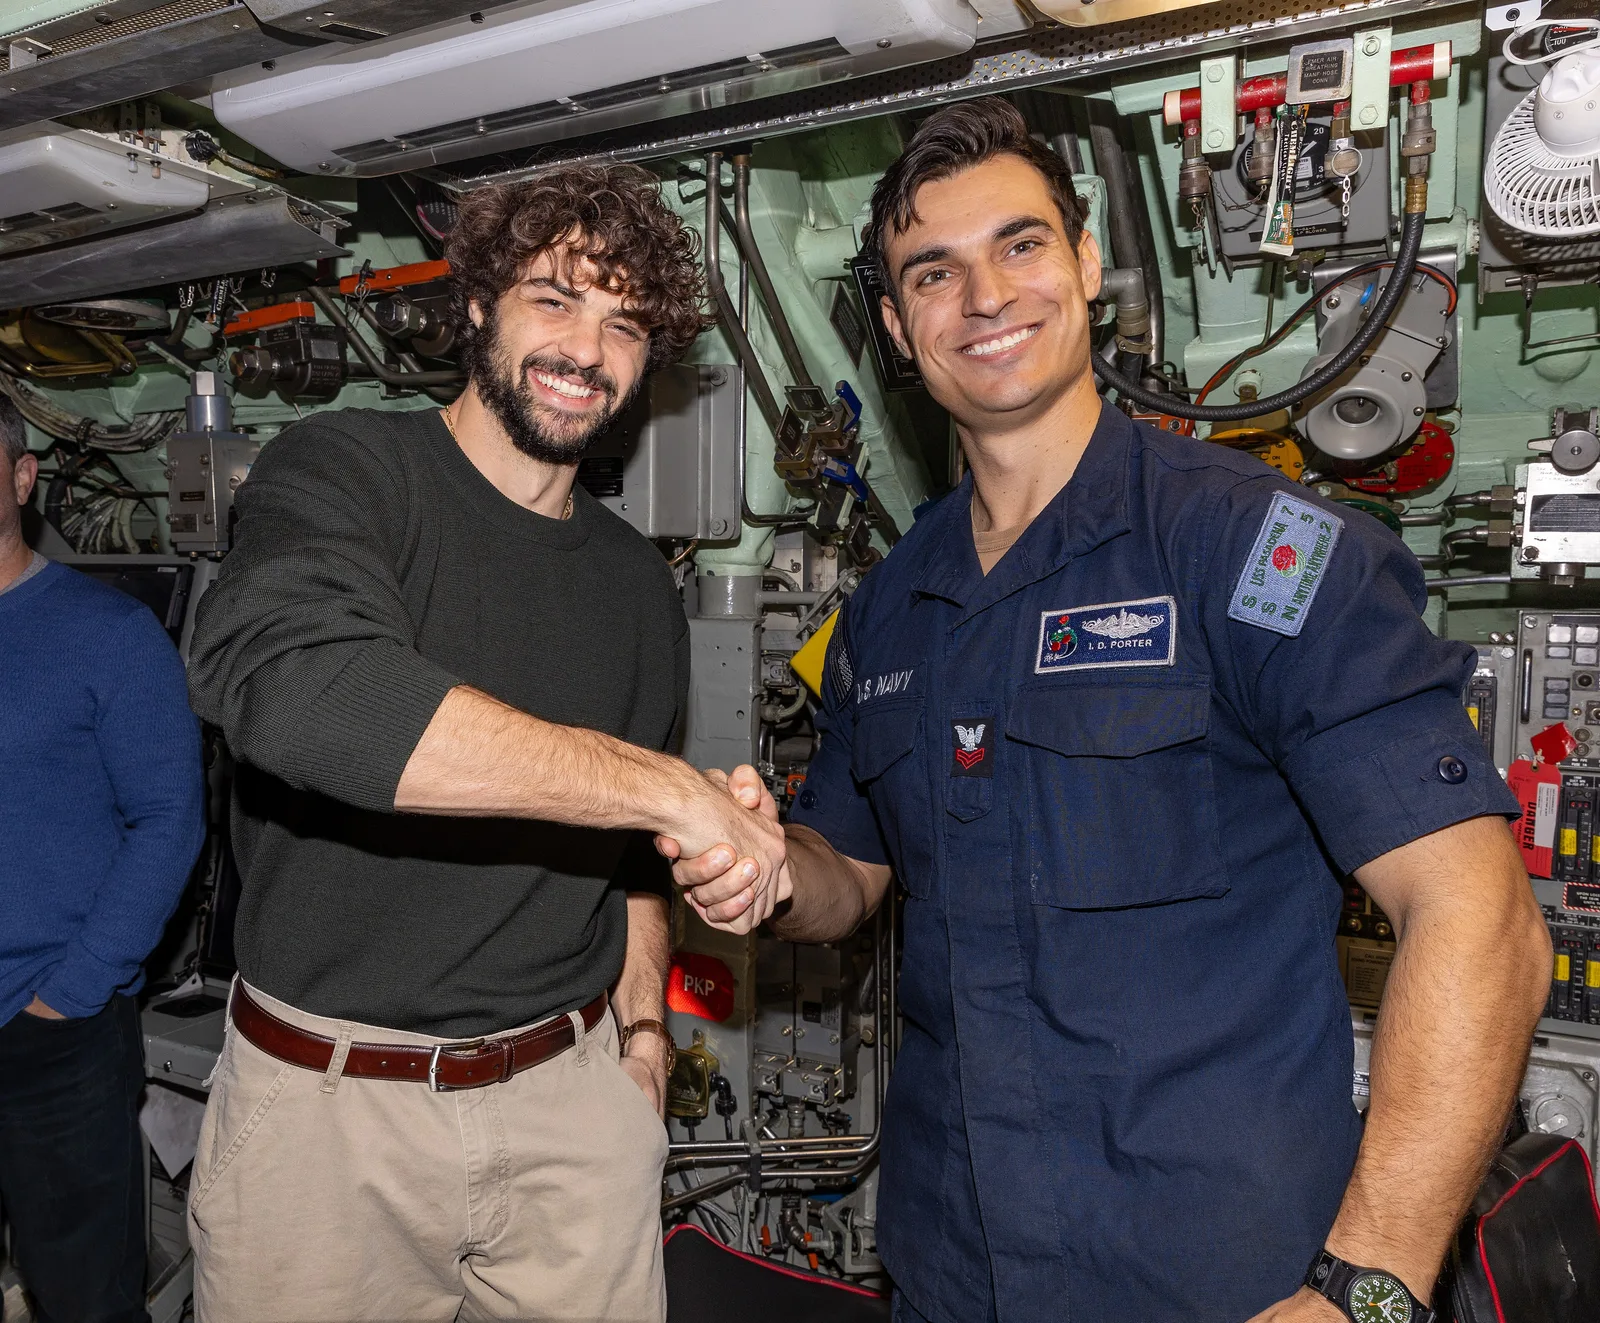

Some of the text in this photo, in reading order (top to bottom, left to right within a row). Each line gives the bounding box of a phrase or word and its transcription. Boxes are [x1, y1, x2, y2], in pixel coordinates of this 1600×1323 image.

[1313, 127, 1324, 136] 20
[1097, 641, 1107, 650] D.
[1110, 638, 1153, 649] PORTER
[874, 669, 914, 697] NAVY
[1522, 801, 1537, 851] DANGER
[684, 974, 715, 996] PKP
[1372, 1279, 1380, 1287] 8
